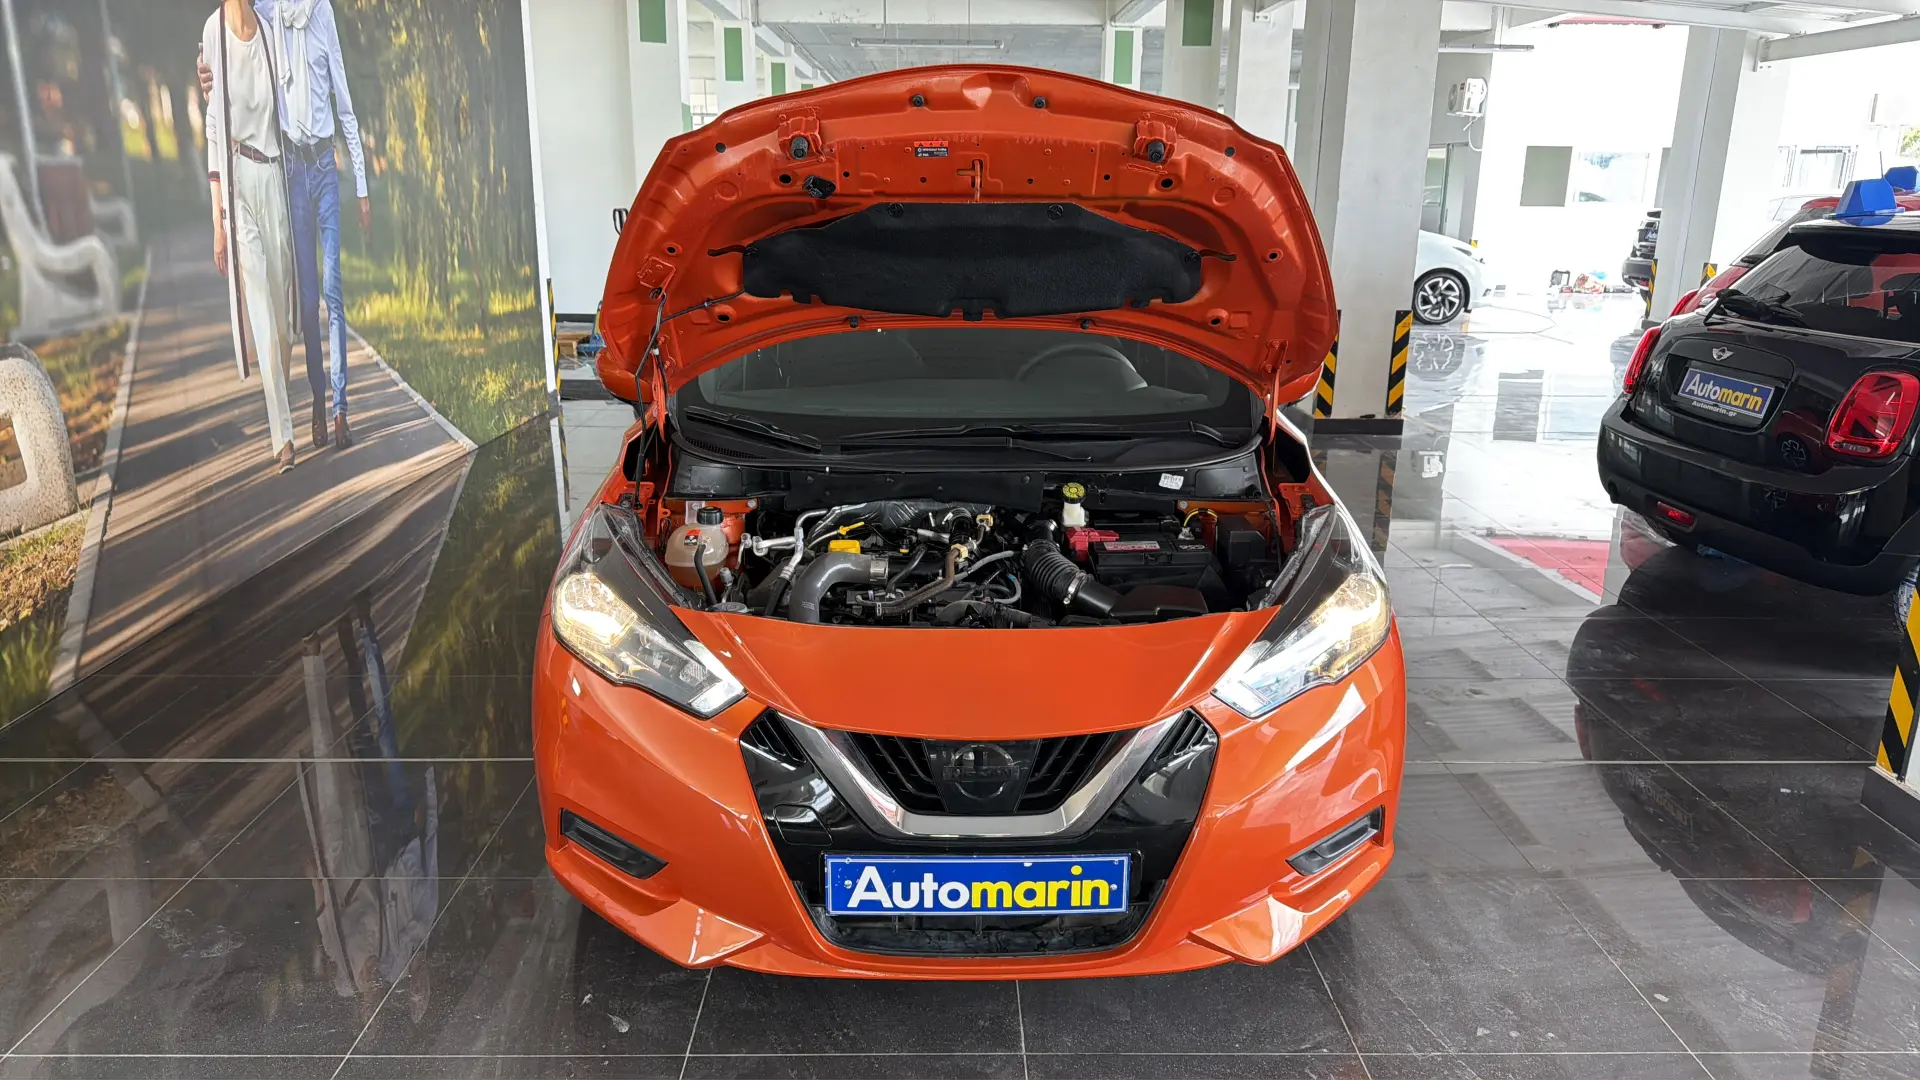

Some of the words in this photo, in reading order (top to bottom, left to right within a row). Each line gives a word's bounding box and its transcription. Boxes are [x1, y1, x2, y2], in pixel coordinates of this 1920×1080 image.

[1685, 373, 1762, 411] Automarin
[1692, 400, 1737, 417] Automarin.gr
[847, 865, 1109, 908] Automarin
